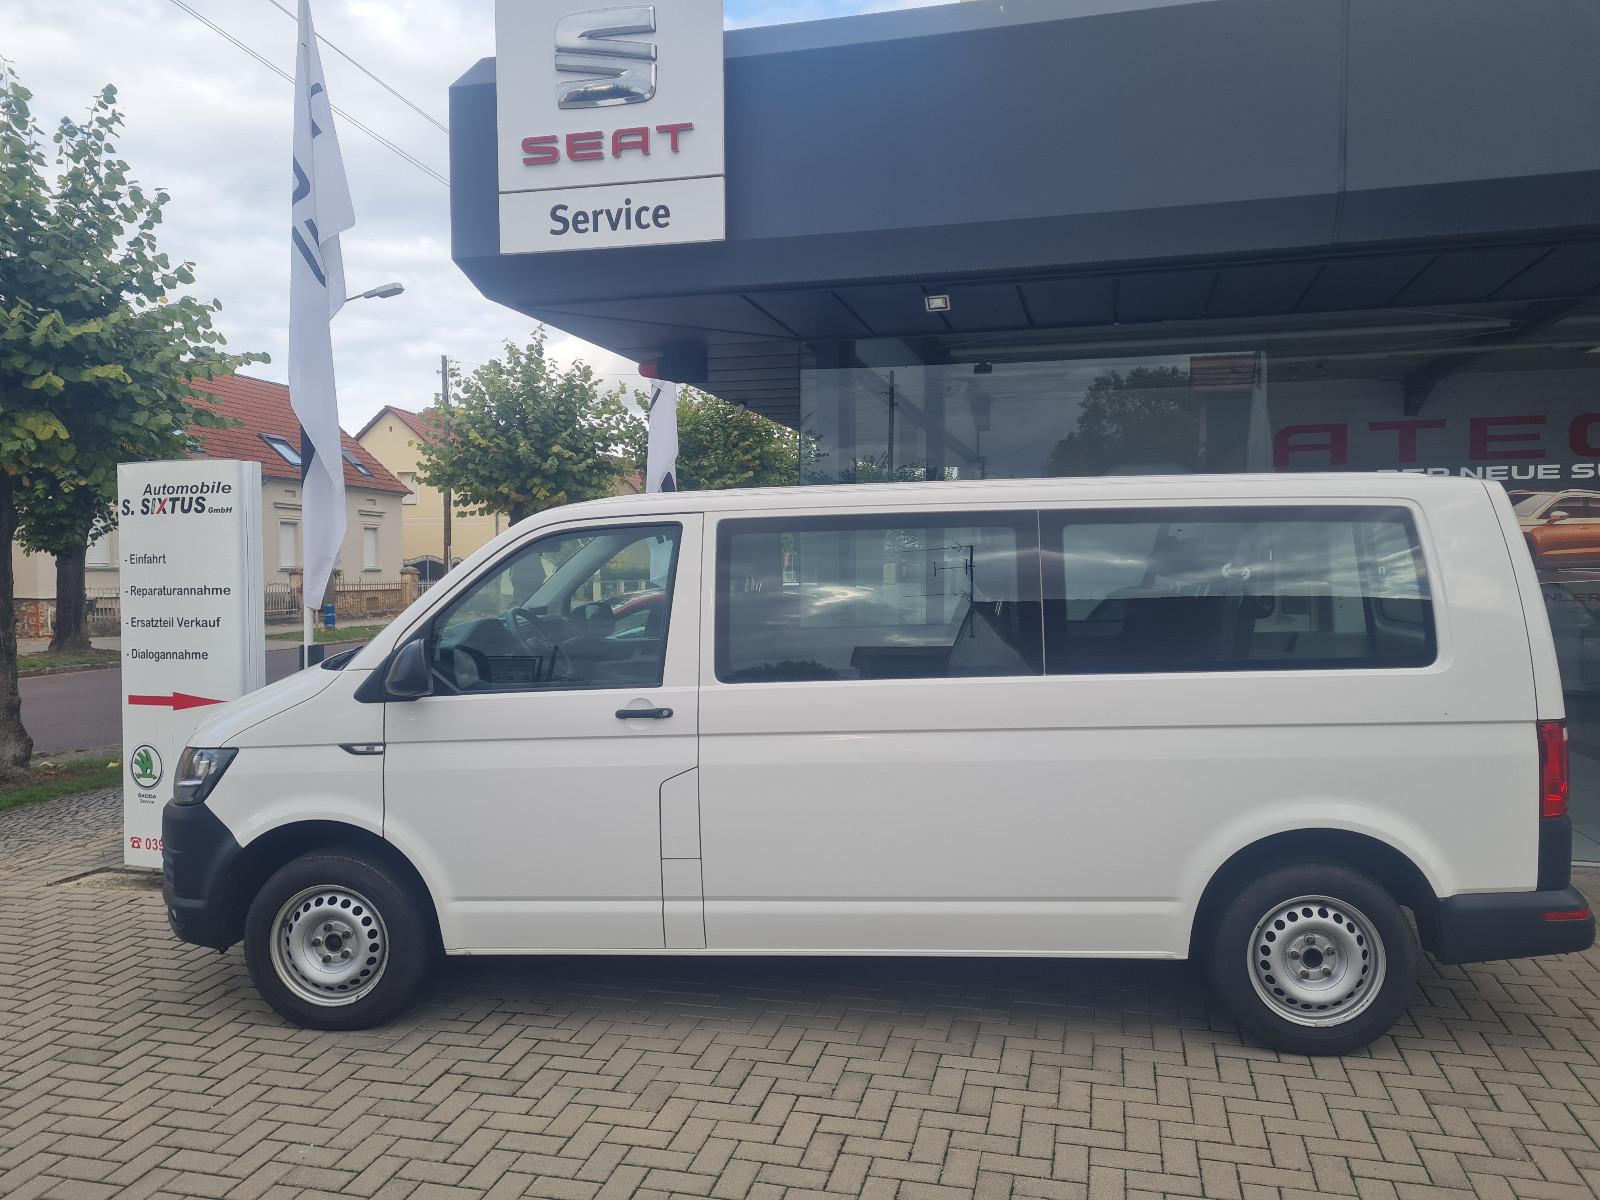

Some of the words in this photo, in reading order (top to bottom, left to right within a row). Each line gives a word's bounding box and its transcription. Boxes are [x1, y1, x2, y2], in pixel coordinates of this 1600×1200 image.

[521, 122, 694, 166] SEAT
[549, 198, 671, 236] Service
[1571, 463, 1600, 479] S
[143, 481, 232, 496] Automobile
[121, 499, 135, 516] S.
[208, 506, 232, 514] GmbH
[129, 554, 167, 565] Einfahrt
[130, 585, 231, 597] Reparaturannahme
[130, 617, 174, 628] Ersatzteil
[177, 617, 221, 628] Verkauf
[131, 648, 209, 662] Dialogannahme
